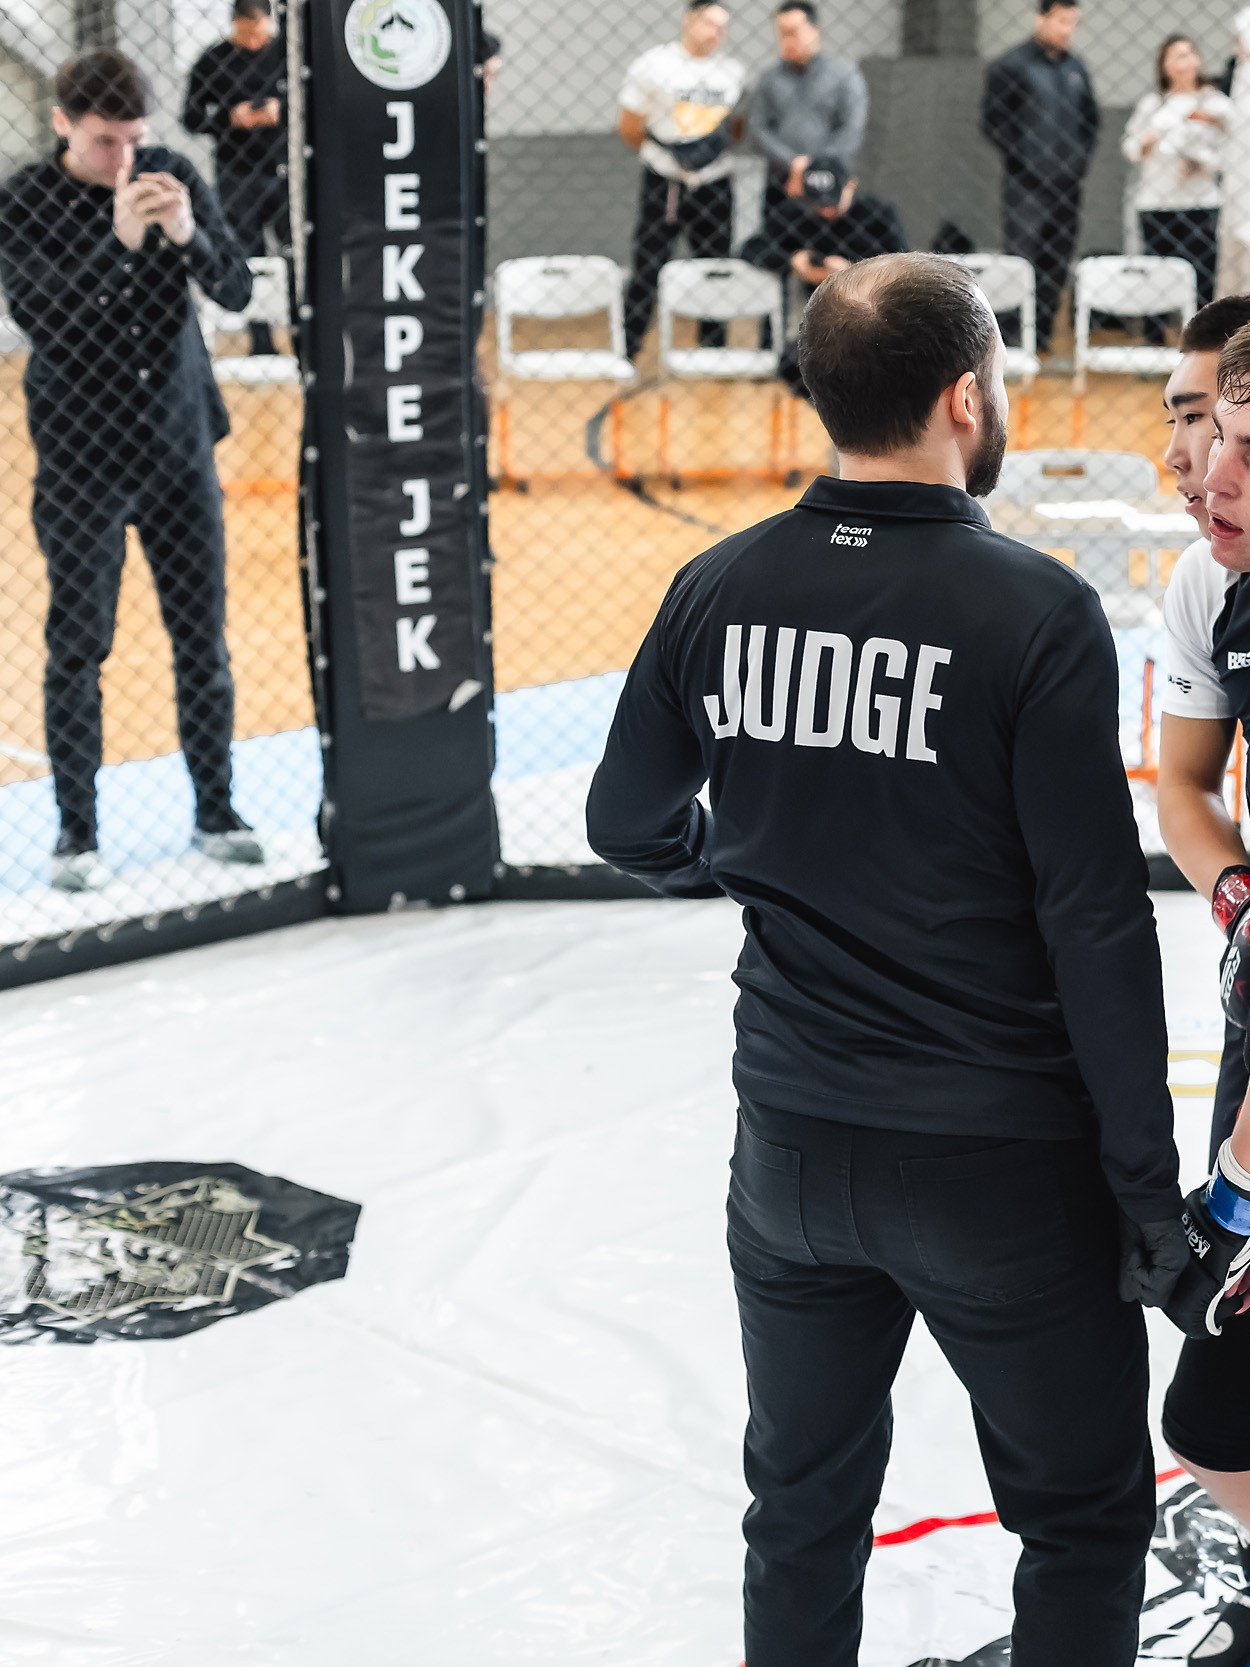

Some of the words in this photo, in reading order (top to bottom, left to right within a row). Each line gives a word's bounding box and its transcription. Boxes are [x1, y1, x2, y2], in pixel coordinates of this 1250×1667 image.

[382, 101, 426, 443] JEKPE
[394, 479, 441, 673] JEK
[834, 523, 872, 536] team
[703, 624, 952, 764] JUDGE
